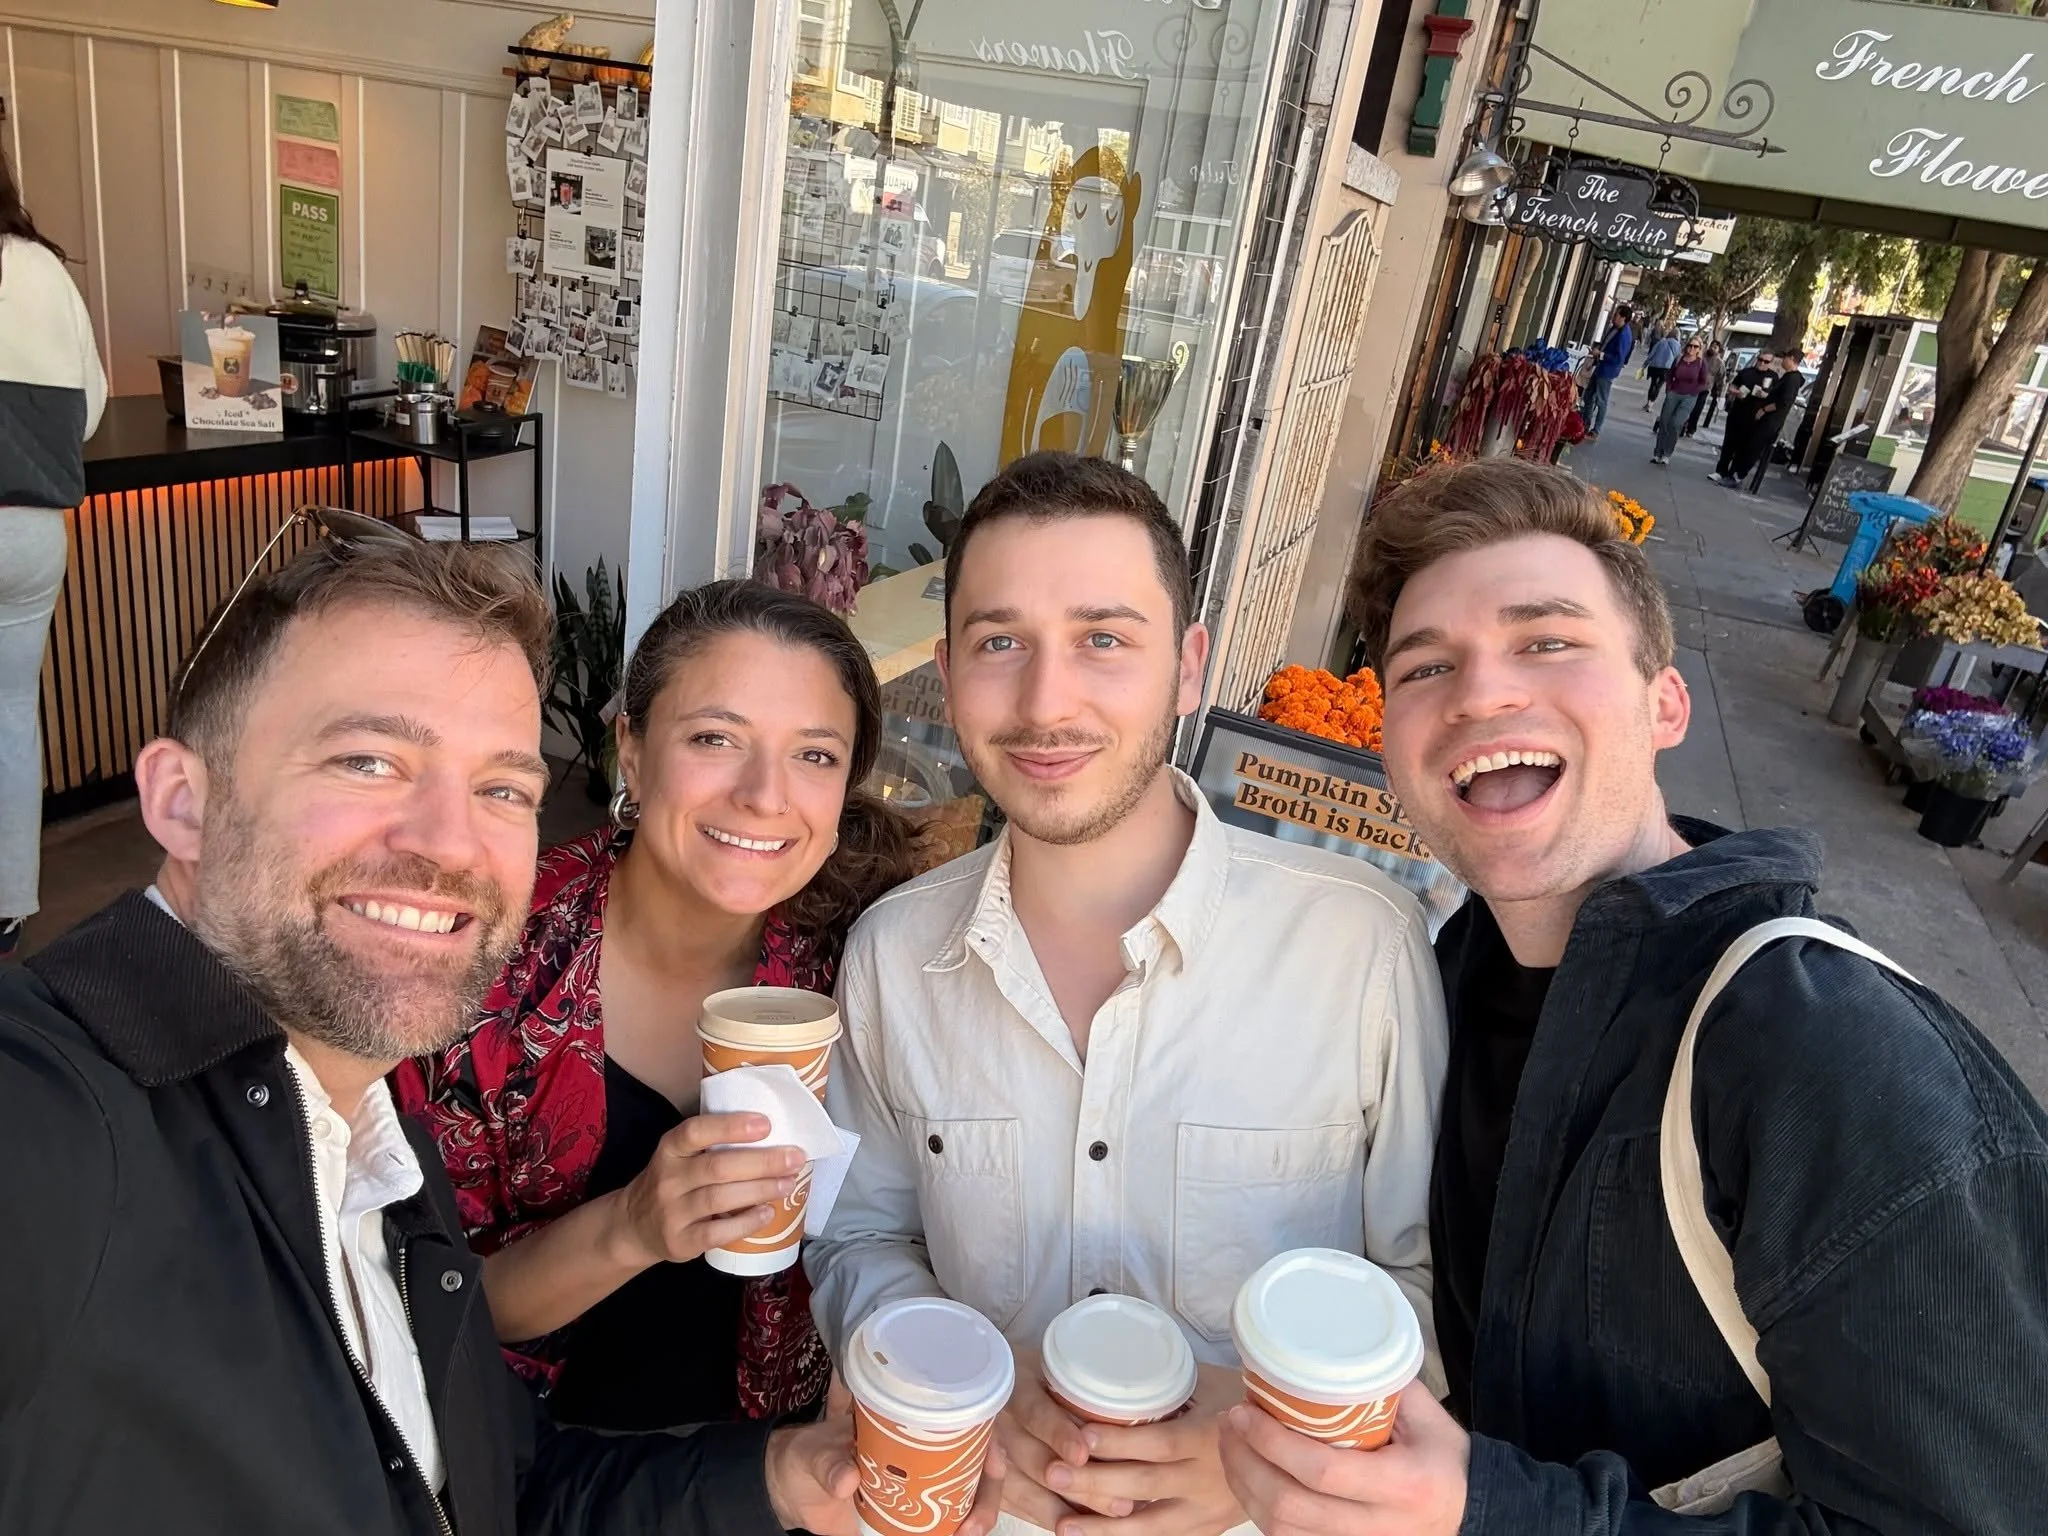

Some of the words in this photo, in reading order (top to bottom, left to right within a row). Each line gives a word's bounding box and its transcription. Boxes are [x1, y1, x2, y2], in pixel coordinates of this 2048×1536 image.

[1815, 29, 2046, 104] French
[1868, 127, 2048, 200] Flowe
[292, 201, 328, 222] PASS
[1577, 174, 1620, 204] The
[1521, 196, 1599, 235] French
[1607, 212, 1668, 246] Tulip
[192, 417, 239, 427] Chocolate
[240, 419, 256, 428] Sea
[257, 419, 275, 429] Salt
[224, 409, 243, 418] Iced
[1236, 751, 1369, 808] Pumpkin
[1375, 792, 1408, 824] Sp
[1238, 781, 1319, 825] Broth
[1324, 807, 1350, 834] is
[1356, 817, 1430, 859] back.
